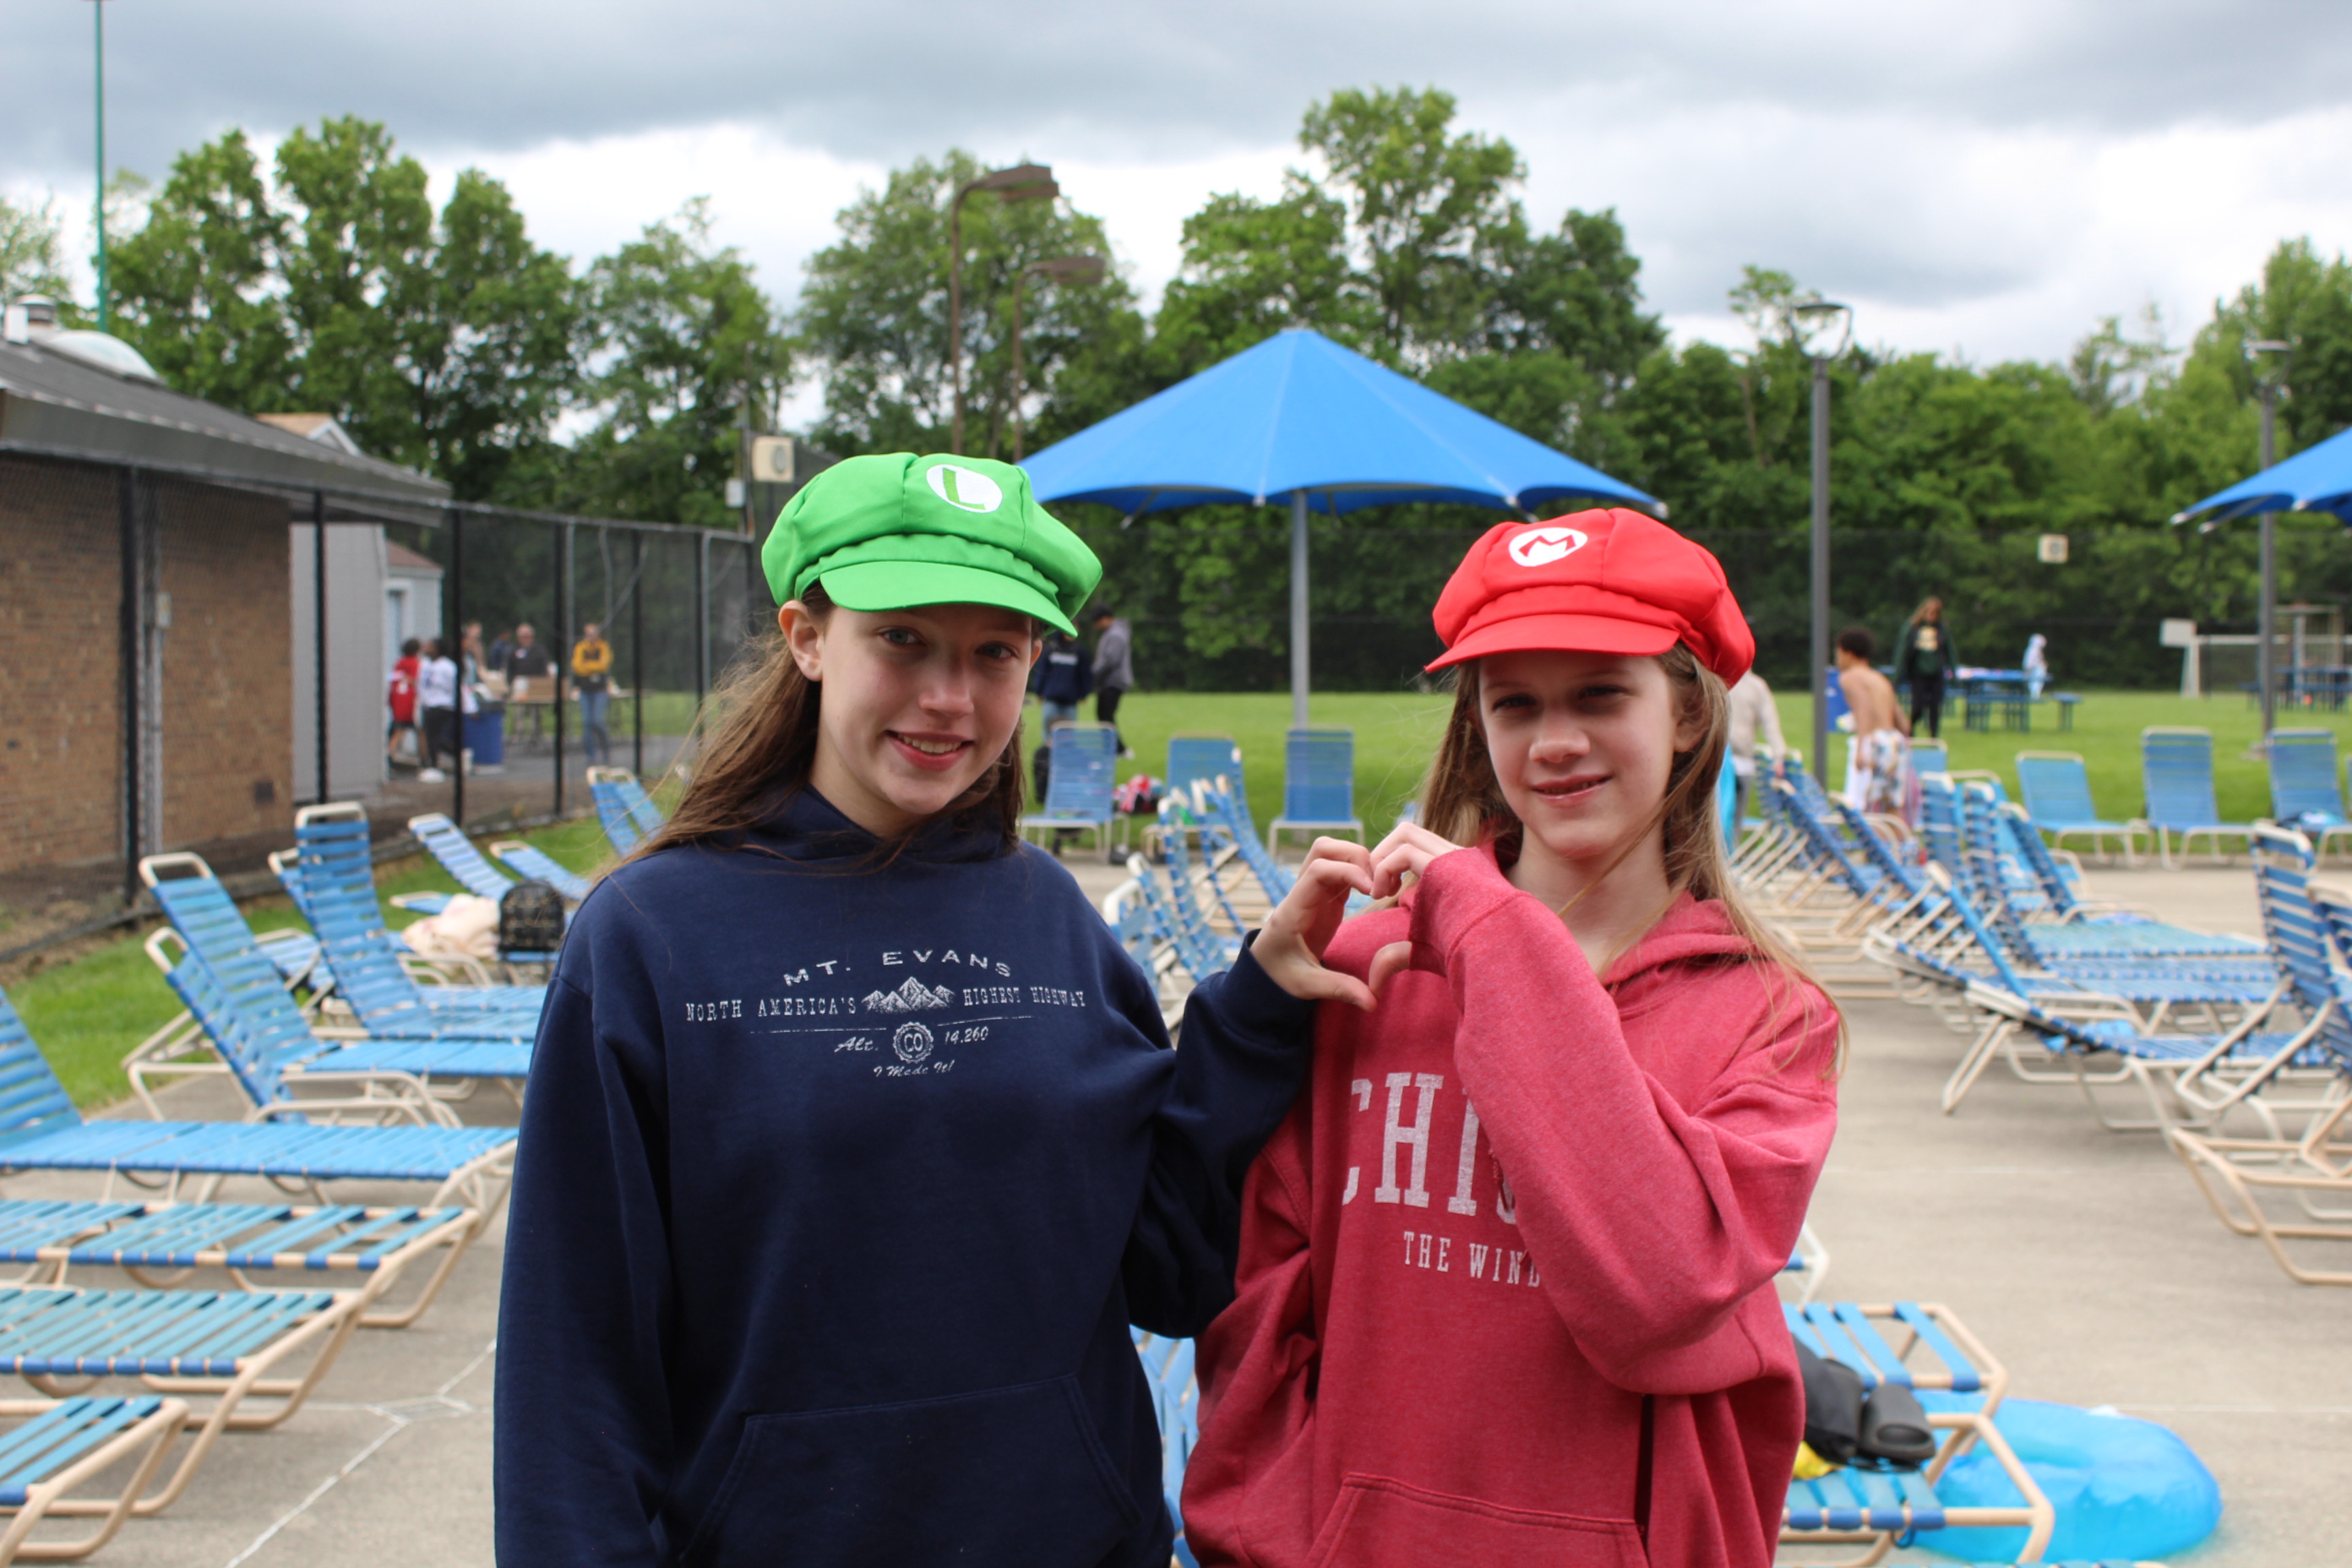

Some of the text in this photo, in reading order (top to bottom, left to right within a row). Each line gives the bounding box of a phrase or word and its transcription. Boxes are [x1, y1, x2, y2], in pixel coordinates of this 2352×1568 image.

[943, 467, 986, 510] L
[1518, 534, 1577, 557] M
[783, 949, 1011, 986] MT. EVANS
[686, 986, 1086, 1022] NORTH AMERICA'S HIGHEST HIGHWAY
[834, 1036, 879, 1053] Alt.
[904, 1032, 924, 1053] CO
[886, 1064, 928, 1077] Made
[1404, 1231, 1451, 1273] THE
